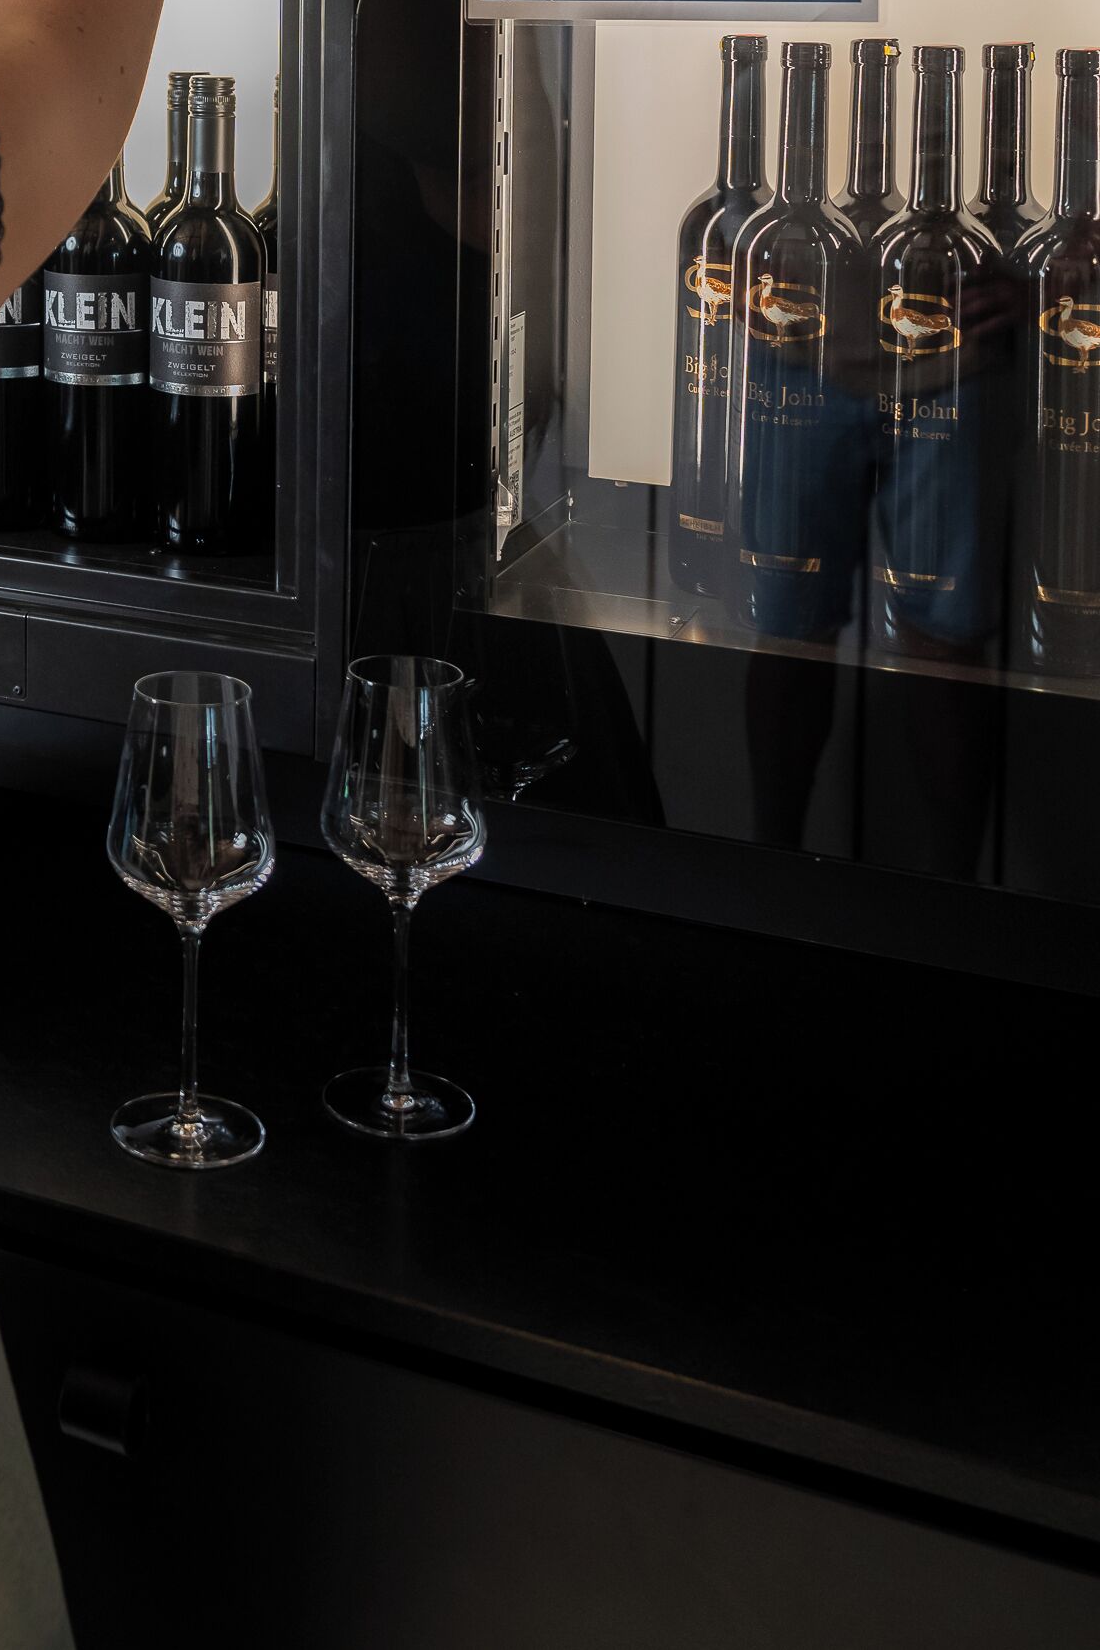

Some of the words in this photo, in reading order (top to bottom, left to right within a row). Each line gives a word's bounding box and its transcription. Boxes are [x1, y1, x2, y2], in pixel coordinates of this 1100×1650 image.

[45, 288, 136, 330] KLEIN
[152, 296, 246, 340] KLEIN
[55, 333, 86, 345] MACHT
[88, 335, 115, 346] WEIN
[162, 342, 195, 356] MACHT
[197, 345, 224, 357] WEIN
[60, 352, 107, 361] ZWEIGELT
[167, 361, 217, 371] ZWEIGELT
[685, 354, 708, 381] Big
[747, 381, 773, 408] Big
[777, 386, 825, 409] John
[878, 393, 905, 421] Big
[908, 398, 958, 421] John
[1042, 407, 1077, 435] Big
